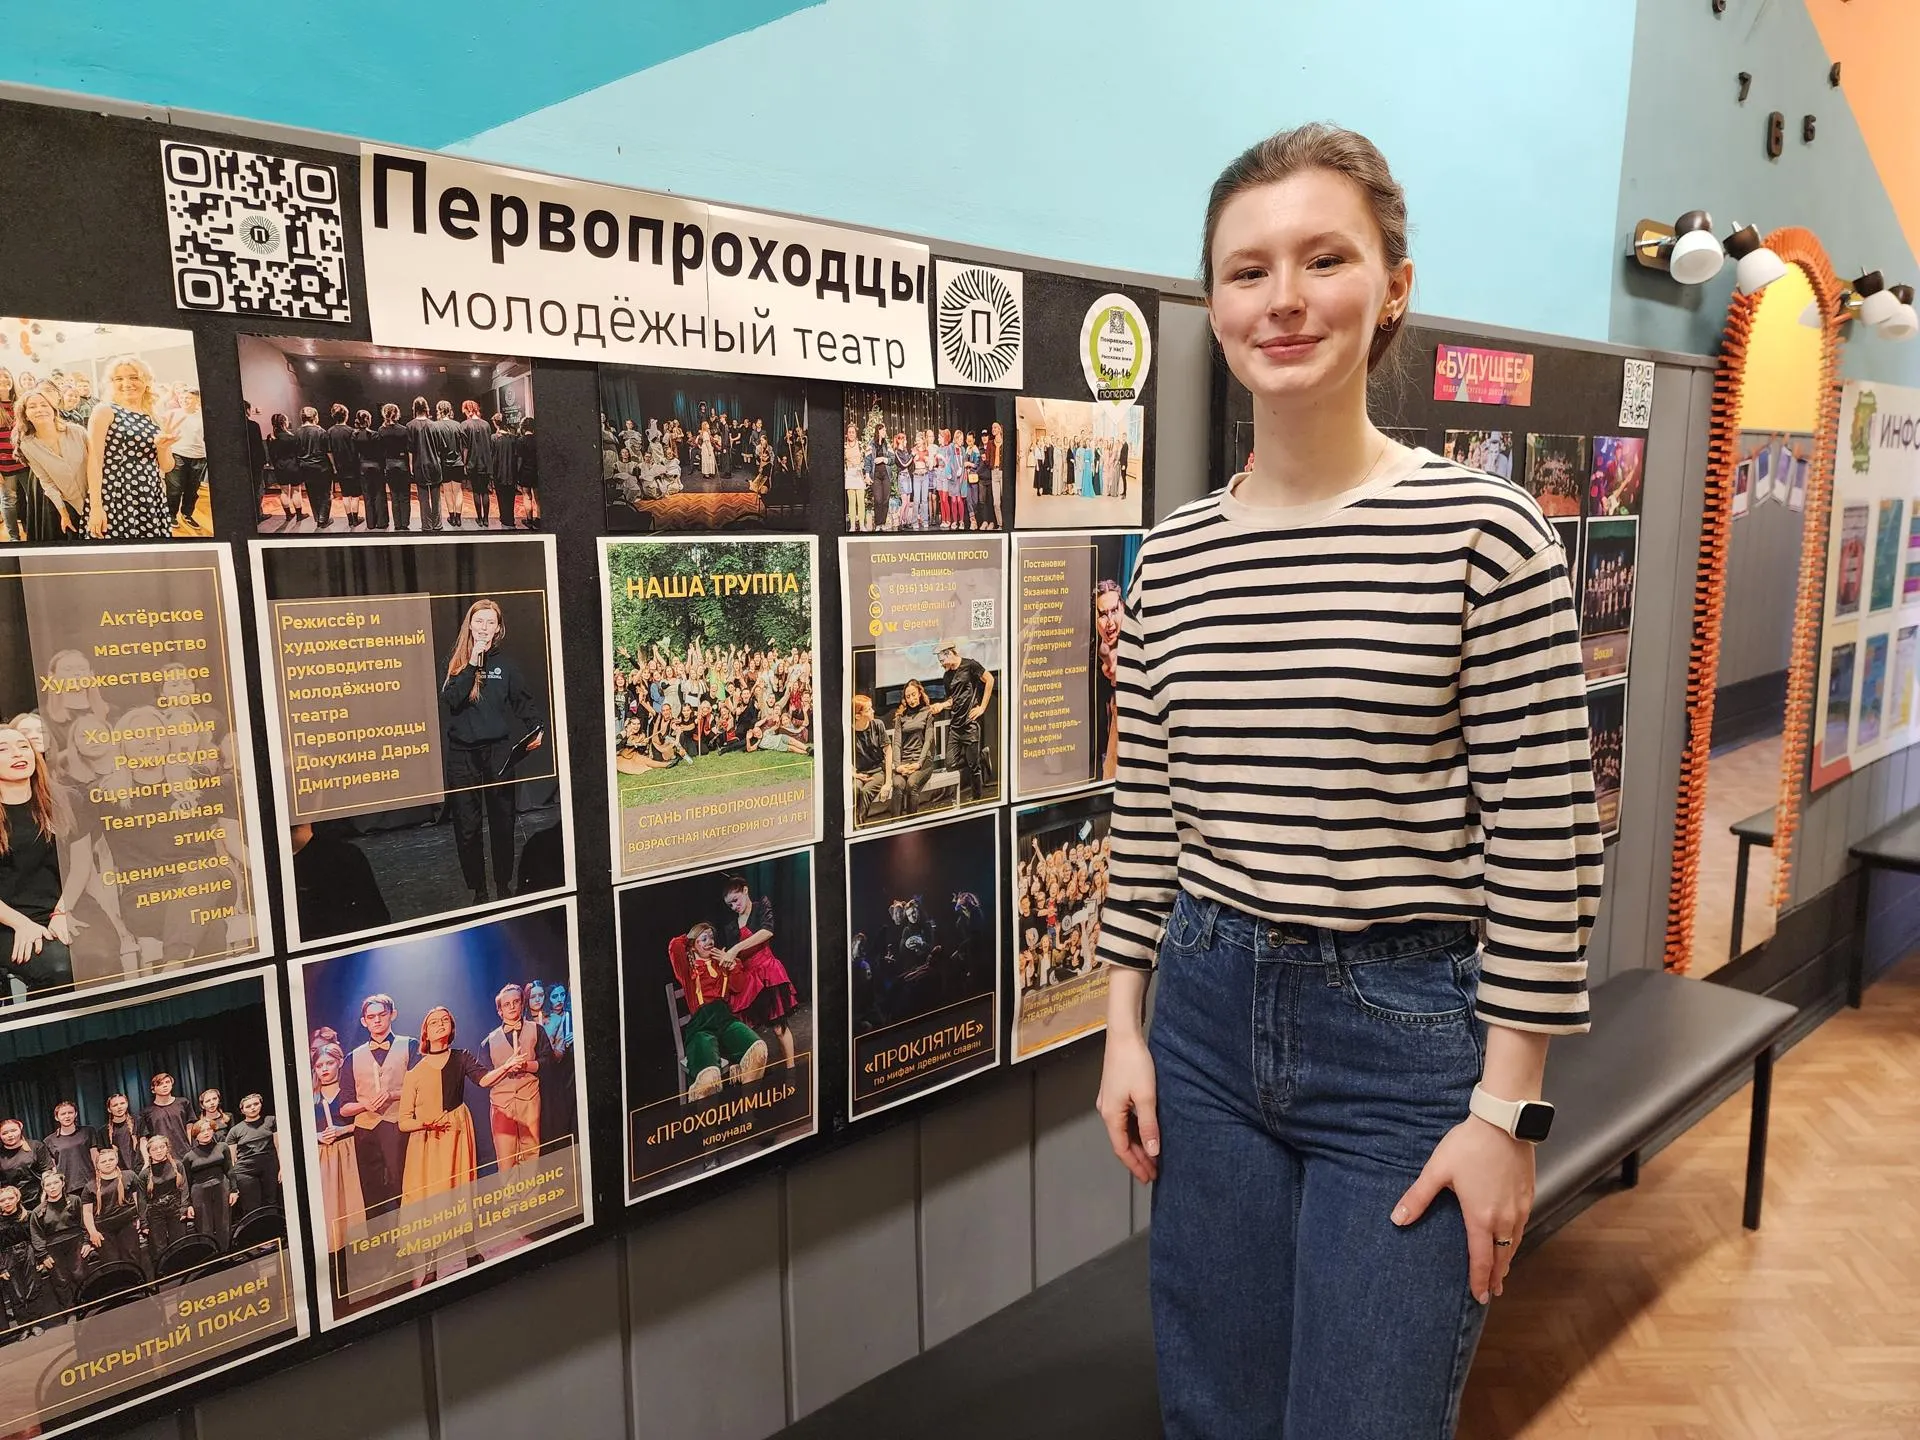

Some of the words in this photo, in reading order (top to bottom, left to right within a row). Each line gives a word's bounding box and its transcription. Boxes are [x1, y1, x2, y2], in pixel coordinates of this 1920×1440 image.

[373, 152, 925, 304] Первопроходцы
[420, 286, 776, 357] молодёжный
[794, 328, 906, 379] театр
[971, 309, 991, 345] П
[1437, 351, 1530, 386] «БУДУЩЕЕ»
[870, 553, 897, 564] СТАТЬ
[898, 551, 956, 562] УЧАСТНИКОМ
[958, 550, 989, 560] ПРОСТО
[1023, 559, 1066, 569] Постановки
[911, 567, 954, 577] Запишись:
[1023, 572, 1064, 583] спектаклей
[626, 575, 705, 600] НАША
[710, 572, 799, 597] ТРУППА
[889, 584, 895, 593] 8
[1023, 587, 1059, 597] Экзамены
[1060, 587, 1069, 595] по
[1023, 600, 1064, 611] актёрскому
[100, 607, 204, 628] Актёрское
[281, 613, 365, 630] Режиссёр
[370, 614, 380, 624] и
[1023, 614, 1063, 625] мастерству
[284, 630, 426, 656] художественный
[1023, 627, 1074, 639] Импровизации
[94, 637, 207, 658] мастерство
[1023, 640, 1072, 652] Литературные
[287, 658, 402, 680] руководитель
[1023, 656, 1048, 666] вечера
[1023, 667, 1063, 679] Новогодние
[1064, 665, 1087, 674] сказки
[40, 665, 210, 693] Художественное
[289, 680, 400, 700] молодёжного
[1023, 681, 1062, 693] Подготовка
[157, 690, 212, 708] слово
[1028, 694, 1064, 706] конкурсам
[292, 707, 349, 724] театра
[1029, 708, 1070, 720] фестивалям
[84, 718, 215, 746] Хореография
[294, 720, 426, 747] Первопроходцы
[1023, 724, 1046, 733] Малые
[1048, 719, 1081, 730] театраль-
[1023, 736, 1038, 745] ные
[1039, 733, 1062, 744] формы
[114, 746, 219, 771] Режиссура
[296, 748, 377, 772] Докукина
[381, 742, 430, 761] Дарья
[1023, 748, 1046, 758] Видео
[1047, 744, 1075, 755] проекты
[89, 773, 222, 803] Сценография
[298, 767, 400, 795] Дмитриевна
[101, 801, 224, 832] Театральная
[639, 807, 683, 829] СТАНЬ
[685, 789, 806, 820] ПЕРВОПРОХОДЦЕМ
[174, 826, 226, 847] этика
[628, 830, 699, 853] ВОЗРАСТНАЯ
[703, 820, 761, 840] КАТЕГОРИЯ
[762, 817, 776, 828] ОТ
[791, 811, 808, 822] ЛЕТ
[102, 853, 229, 886] Сценическое
[136, 877, 232, 908] движение
[190, 904, 235, 926] Грим
[864, 1020, 984, 1073] «ПРОКЛЯТИЕ»
[874, 1075, 885, 1086] по
[886, 1064, 915, 1081] мифам
[917, 1051, 952, 1071] древних
[953, 1041, 981, 1056] славян
[646, 1083, 796, 1146] «ПРОХОДИМЦЫ»
[703, 1121, 753, 1147] клоунада
[349, 1199, 467, 1255] Театральный
[471, 1166, 564, 1210] перфоманс
[395, 1222, 474, 1258] «Марина
[478, 1187, 565, 1230] Цветаева»
[178, 1276, 268, 1317] Экзамен
[60, 1323, 191, 1387] ОТКРЫТЫЙ
[198, 1297, 271, 1338] ПОКАЗ
